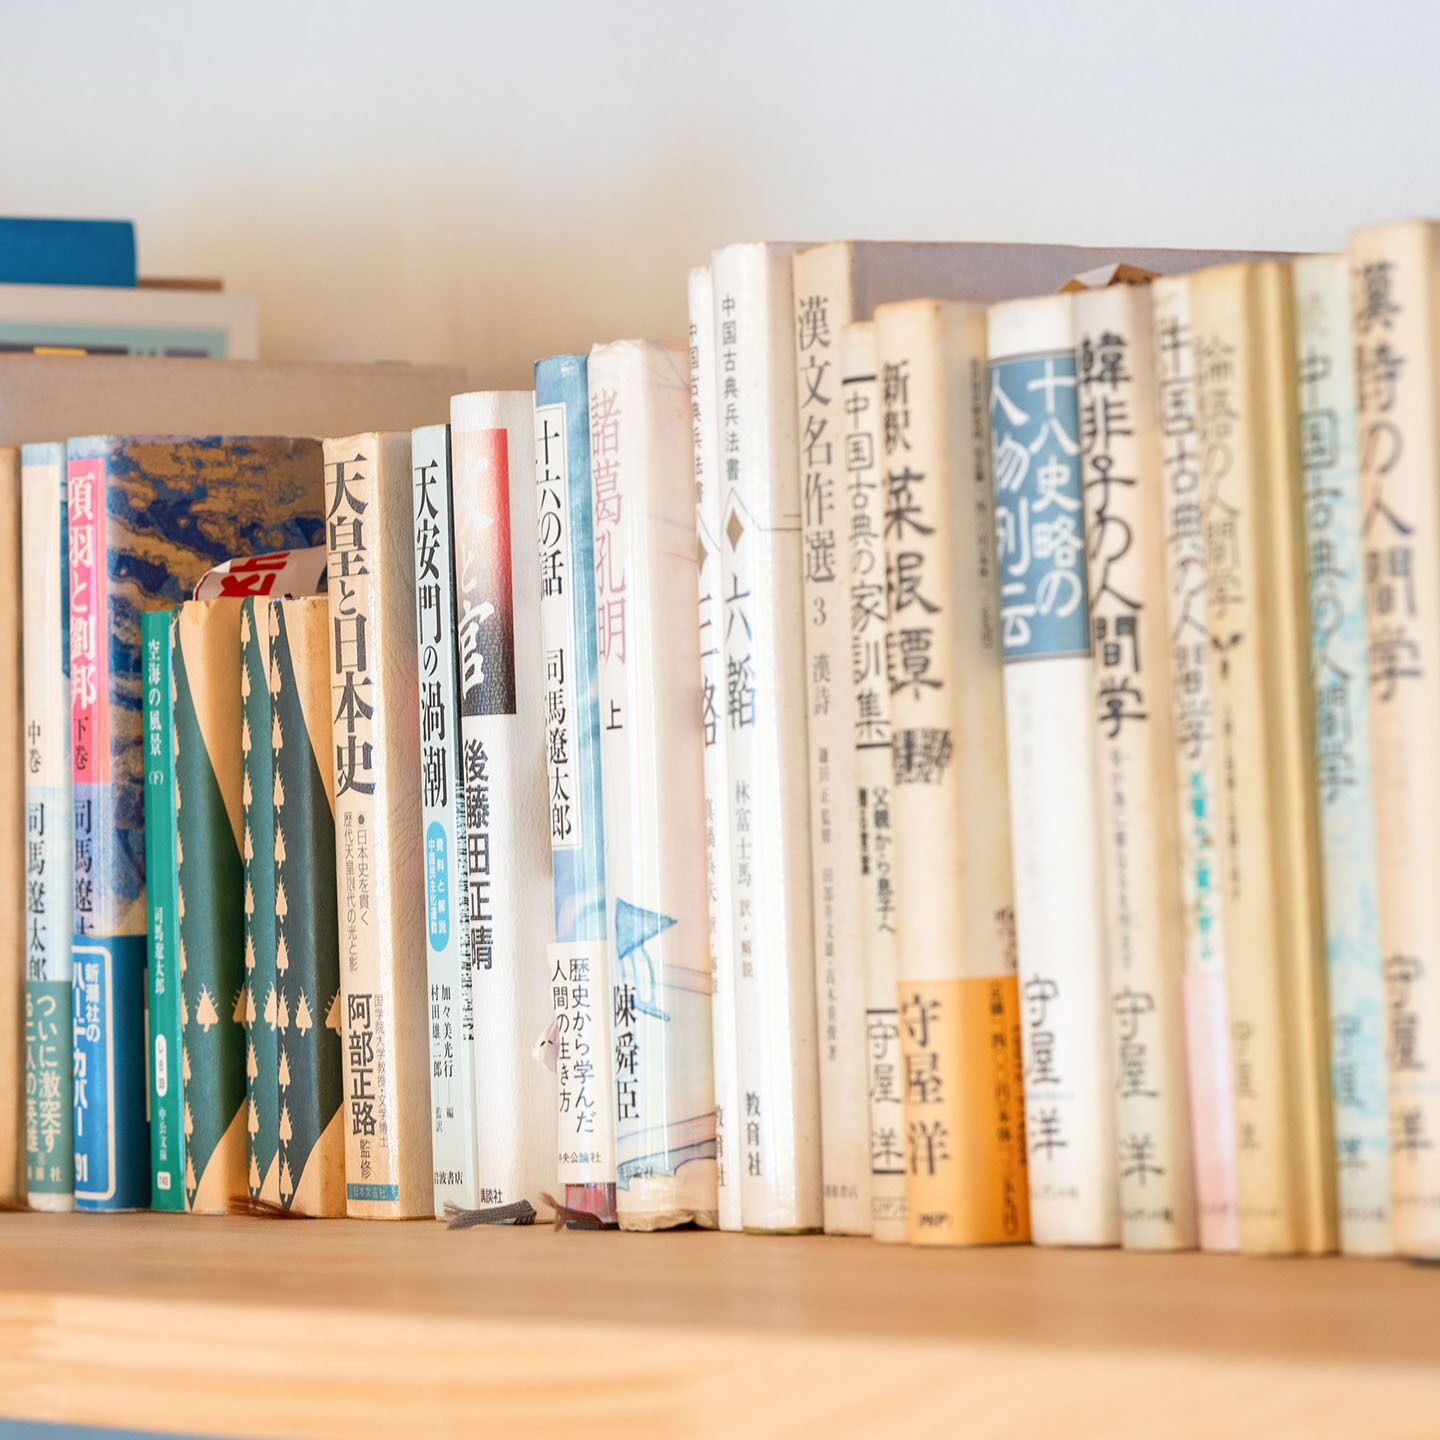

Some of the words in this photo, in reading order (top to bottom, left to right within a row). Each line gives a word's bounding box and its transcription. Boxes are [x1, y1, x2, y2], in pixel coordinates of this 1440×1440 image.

[721, 294, 742, 482] 中国古典兵法書
[798, 296, 837, 585] 漢文名作選
[536, 419, 564, 599] 十六の話
[591, 387, 627, 666] 諸葛孔明
[844, 390, 892, 740] 中国古典の家訓集
[1026, 358, 1085, 619] 十八史略の
[1077, 331, 1150, 739] 韓非子の人間学
[67, 473, 98, 710] 項羽と劉邦
[325, 453, 376, 798] 天皇と日本史
[414, 459, 448, 809] 天安門の渦潮
[725, 573, 756, 730] 六韜
[813, 597, 827, 627] 3
[883, 466, 944, 700] 菜根譚
[27, 719, 43, 775] 中巻
[74, 716, 89, 772] 下巻
[147, 638, 162, 758] 空海の風景
[545, 647, 572, 841] 司馬遼太郎
[605, 698, 624, 731] 上
[812, 653, 832, 717] 漢詩
[27, 801, 48, 980] 司馬遼太郎
[343, 811, 359, 973] 歴代天皇124代の光と影
[356, 827, 371, 928] 日本史を貫く
[435, 838, 448, 935] 資料と解説
[463, 737, 494, 971] 後藤田正晴
[734, 780, 753, 888] 林富士馬
[84, 962, 101, 1043] 新潮社の
[153, 906, 166, 995] 司馬遼太郎
[37, 994, 62, 1155] ついに激突す
[72, 961, 88, 1137] ハードカバー
[347, 992, 377, 1137] 阿部正路
[430, 984, 443, 1079] 村田雄二郎
[441, 984, 454, 1079] 加々美光行
[551, 958, 573, 1113] 人間の生き方
[568, 957, 595, 1135] 歴史から学んだ
[613, 984, 640, 1122] 陳舜臣
[902, 993, 951, 1177] 守屋洋
[1023, 972, 1069, 1163] 守屋洋
[1114, 987, 1168, 1188] 守屋洋
[73, 1153, 89, 1184] 91
[358, 1139, 372, 1179] 監修
[745, 1091, 763, 1177] 教育社
